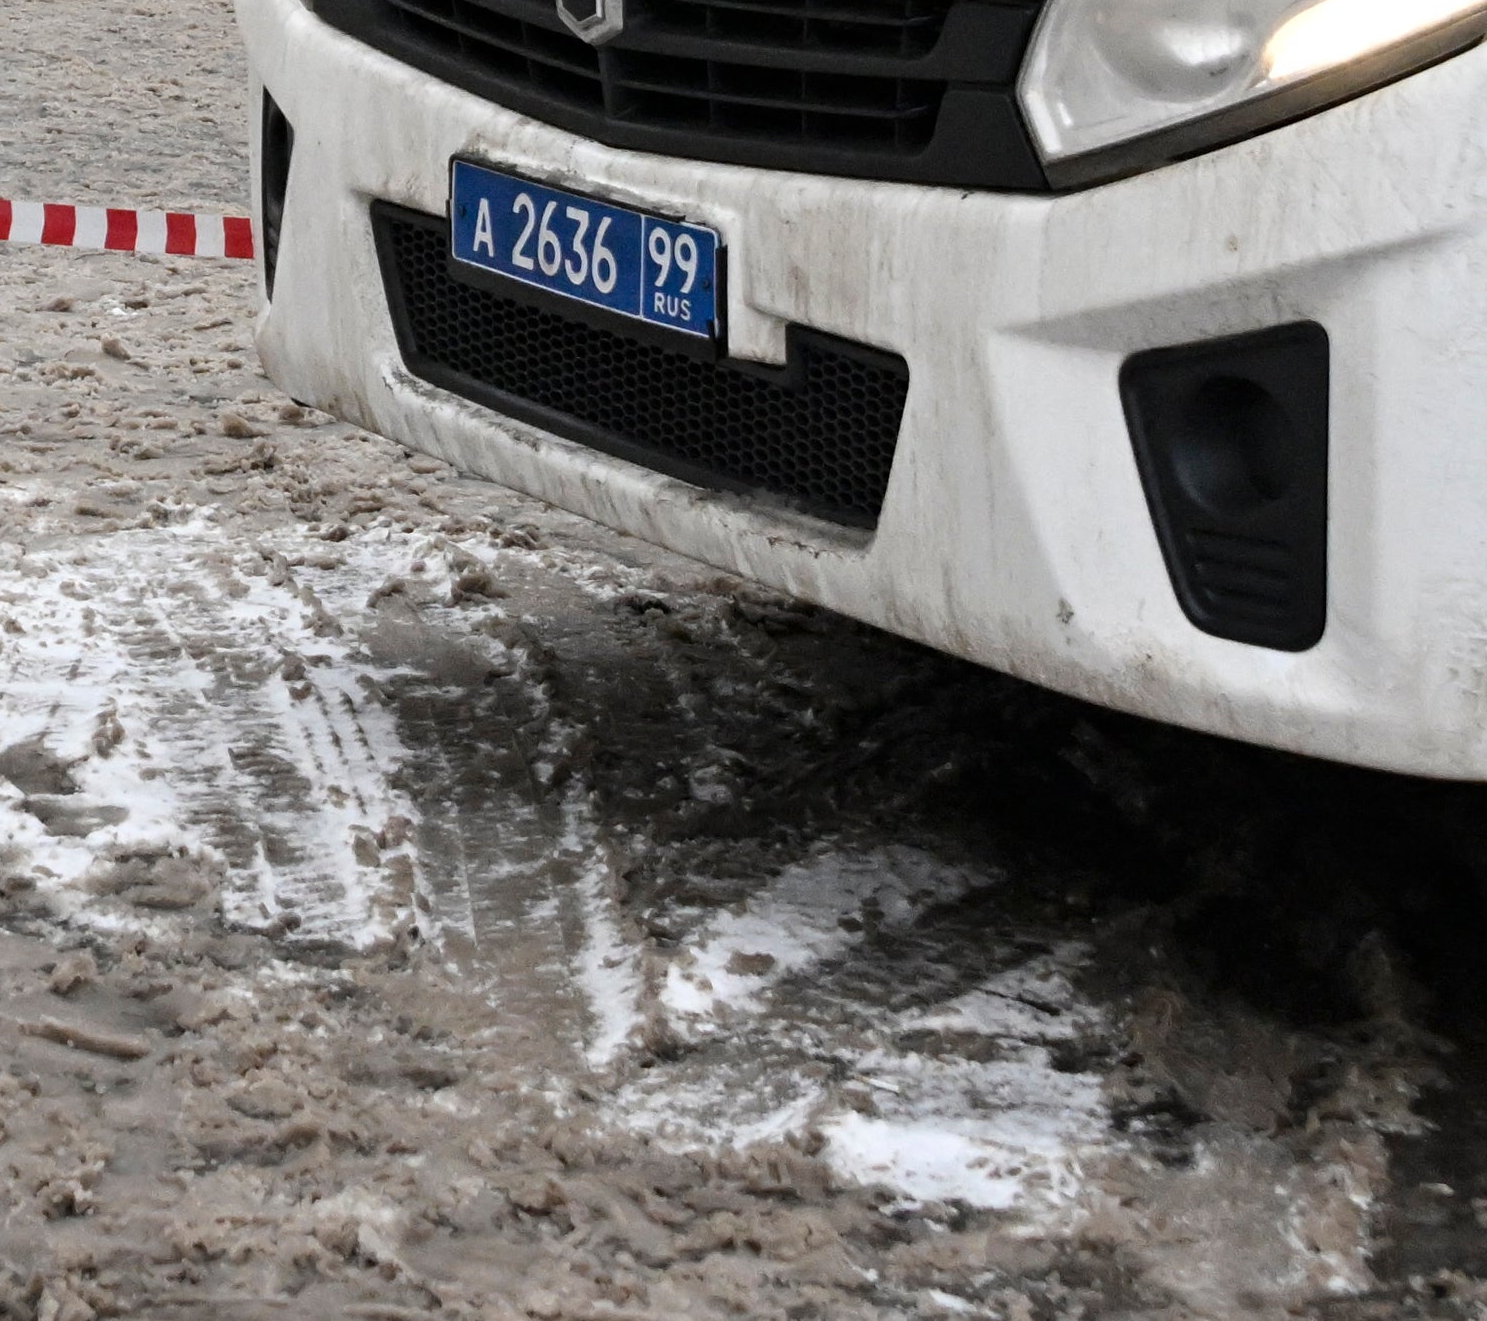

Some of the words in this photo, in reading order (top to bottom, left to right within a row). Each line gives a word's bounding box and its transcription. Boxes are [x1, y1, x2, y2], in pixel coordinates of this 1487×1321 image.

[472, 198, 494, 258] А
[511, 192, 617, 295] 2636
[648, 226, 698, 294] 99
[653, 292, 692, 321] RUS
